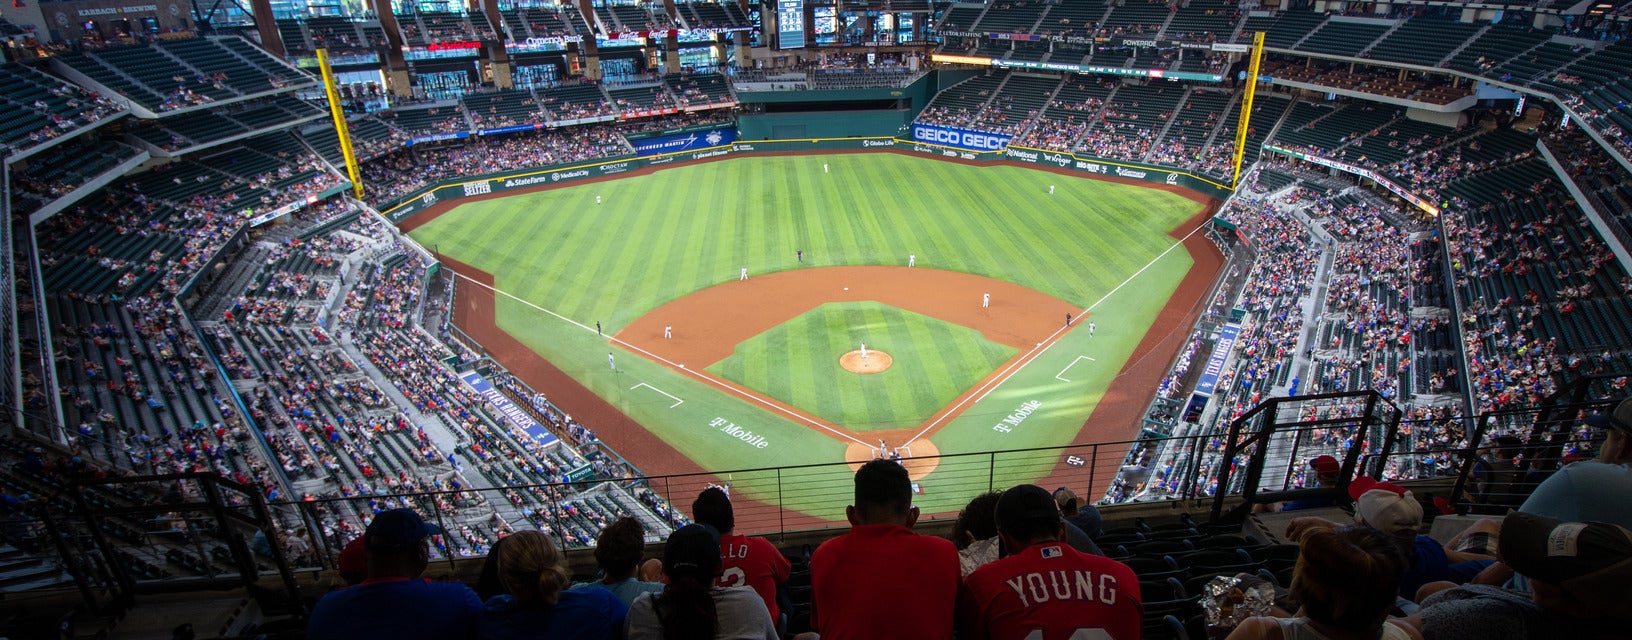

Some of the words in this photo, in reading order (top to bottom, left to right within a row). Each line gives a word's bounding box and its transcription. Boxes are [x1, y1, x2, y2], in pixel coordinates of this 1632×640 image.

[78, 7, 117, 16] KARBACH
[122, 5, 157, 13] BREWING
[563, 34, 584, 43] Bank
[664, 140, 685, 148] MARTIN
[914, 127, 960, 145] GEICO
[962, 133, 1009, 149] GEICO
[697, 151, 713, 159] planet
[713, 149, 728, 157] fitness
[1013, 151, 1038, 160] National
[1052, 154, 1071, 167] Kroger
[464, 182, 491, 196] SELTZER
[1213, 338, 1233, 359] RANGERS
[1205, 358, 1223, 376] TEXAS
[484, 387, 508, 406] TEXAS
[501, 403, 536, 429] RANGERS
[1002, 400, 1042, 427] Mobile
[720, 422, 769, 448] Mobile
[570, 467, 593, 479] TOYOTA
[1006, 570, 1117, 608] YOUNG
